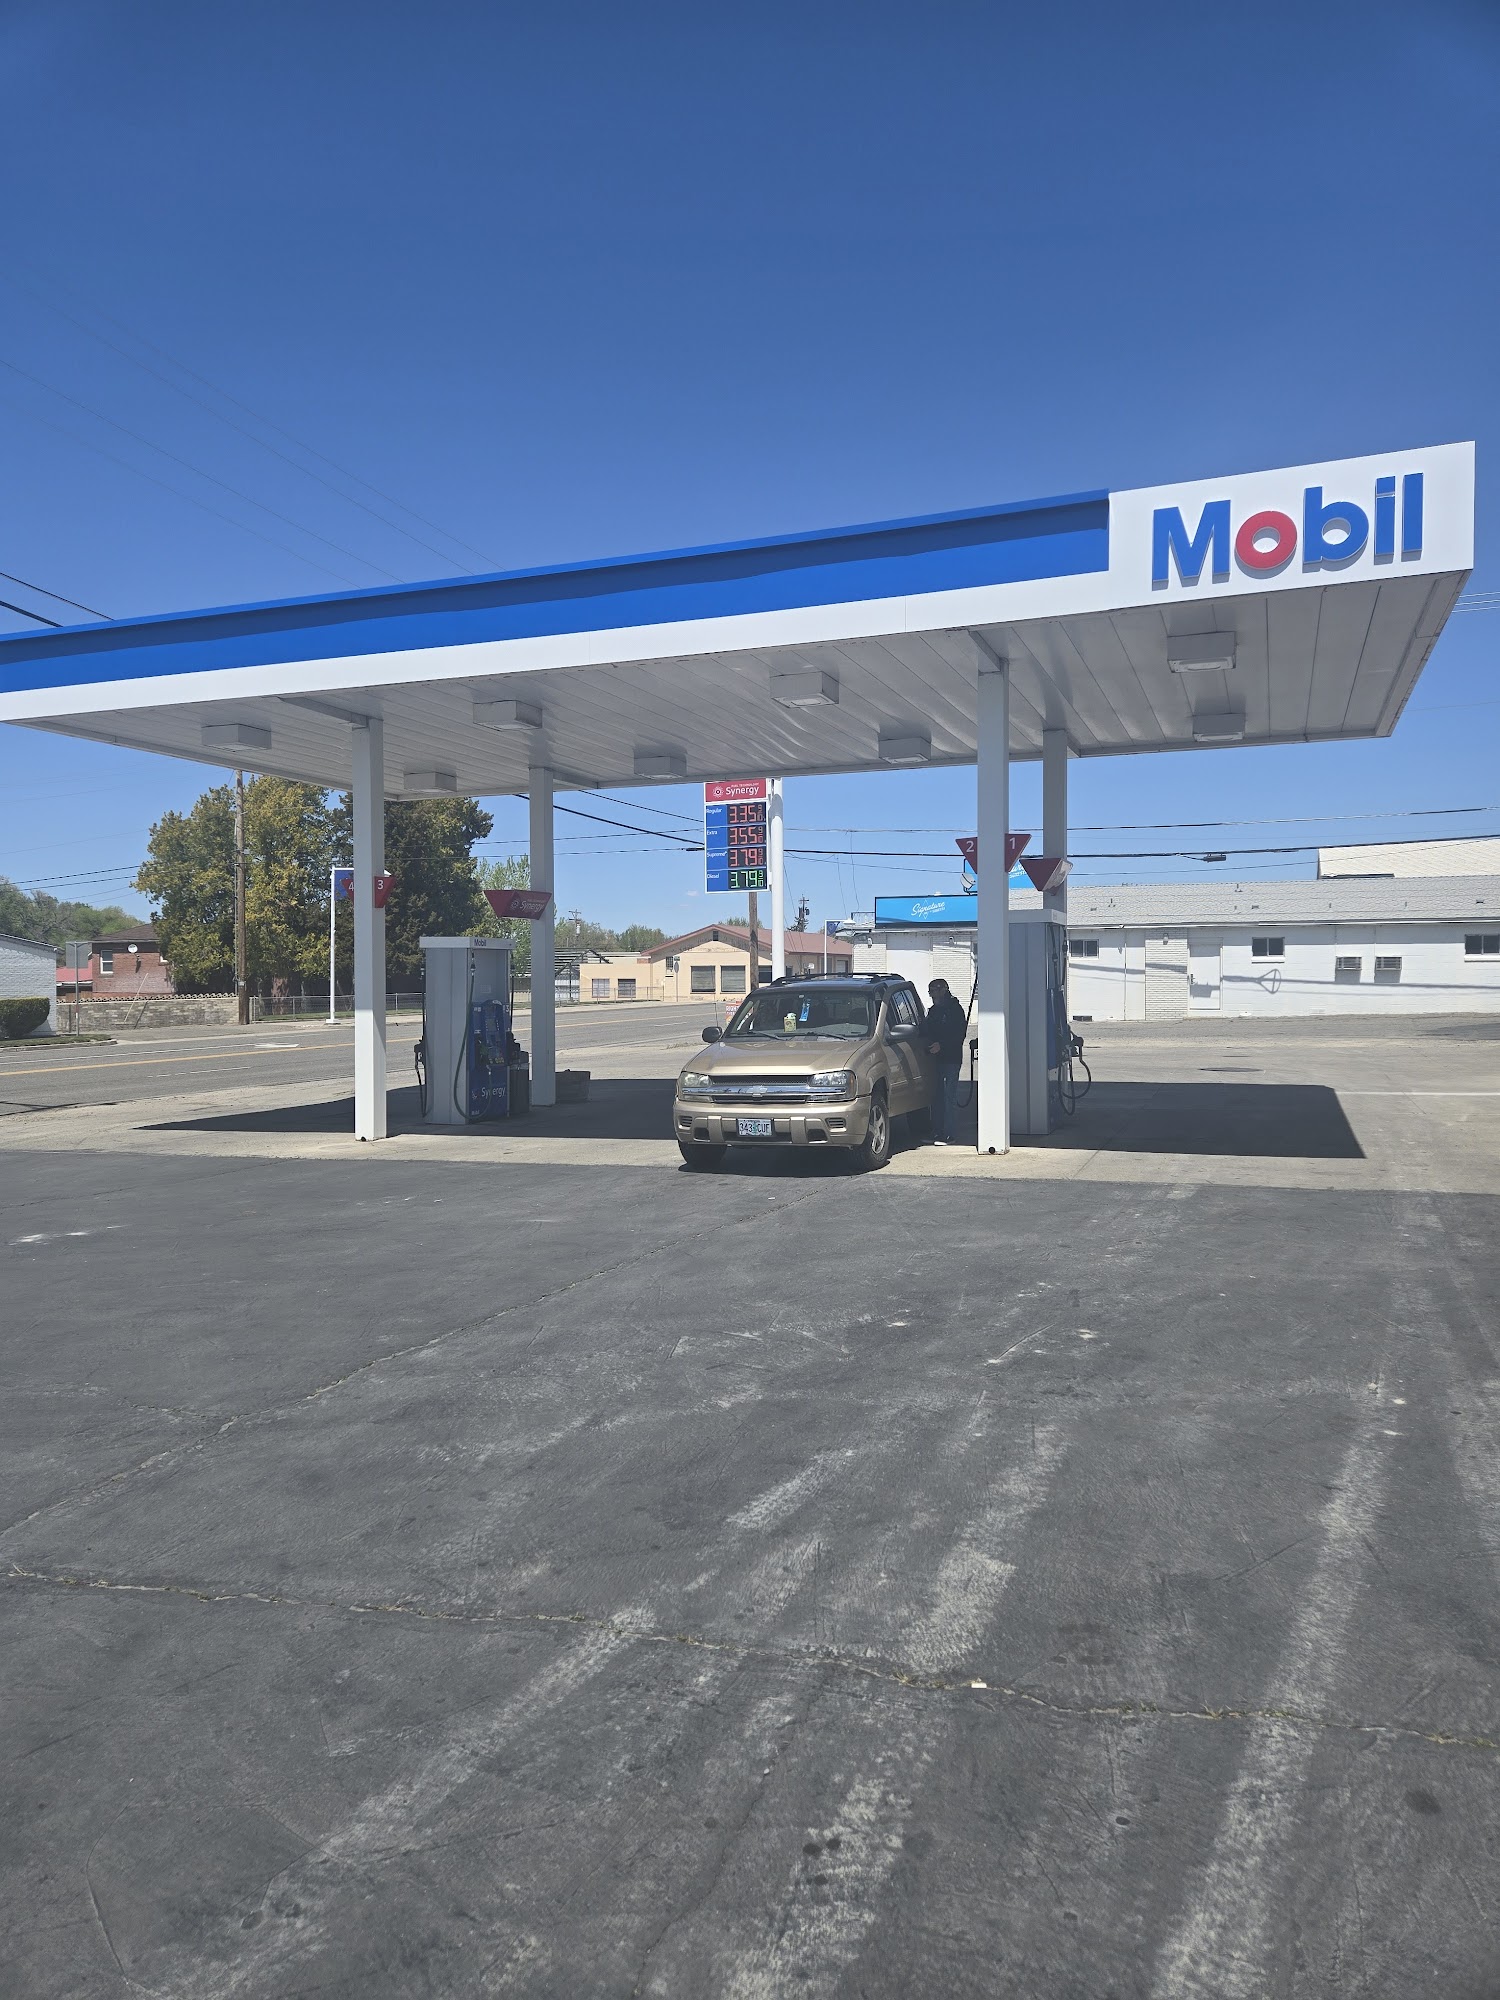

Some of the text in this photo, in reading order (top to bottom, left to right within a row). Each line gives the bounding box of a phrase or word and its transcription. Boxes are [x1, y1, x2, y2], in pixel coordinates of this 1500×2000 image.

[1152, 473, 1423, 591] Mobil
[726, 786, 759, 796] Synergy
[966, 840, 975, 853] 2
[1009, 837, 1016, 850] 1
[348, 881, 355, 892] 4
[376, 879, 384, 890] 3
[520, 901, 545, 912] Synergy
[911, 901, 946, 918] Signature
[474, 939, 487, 947] Mobil
[739, 1122, 753, 1133] 343
